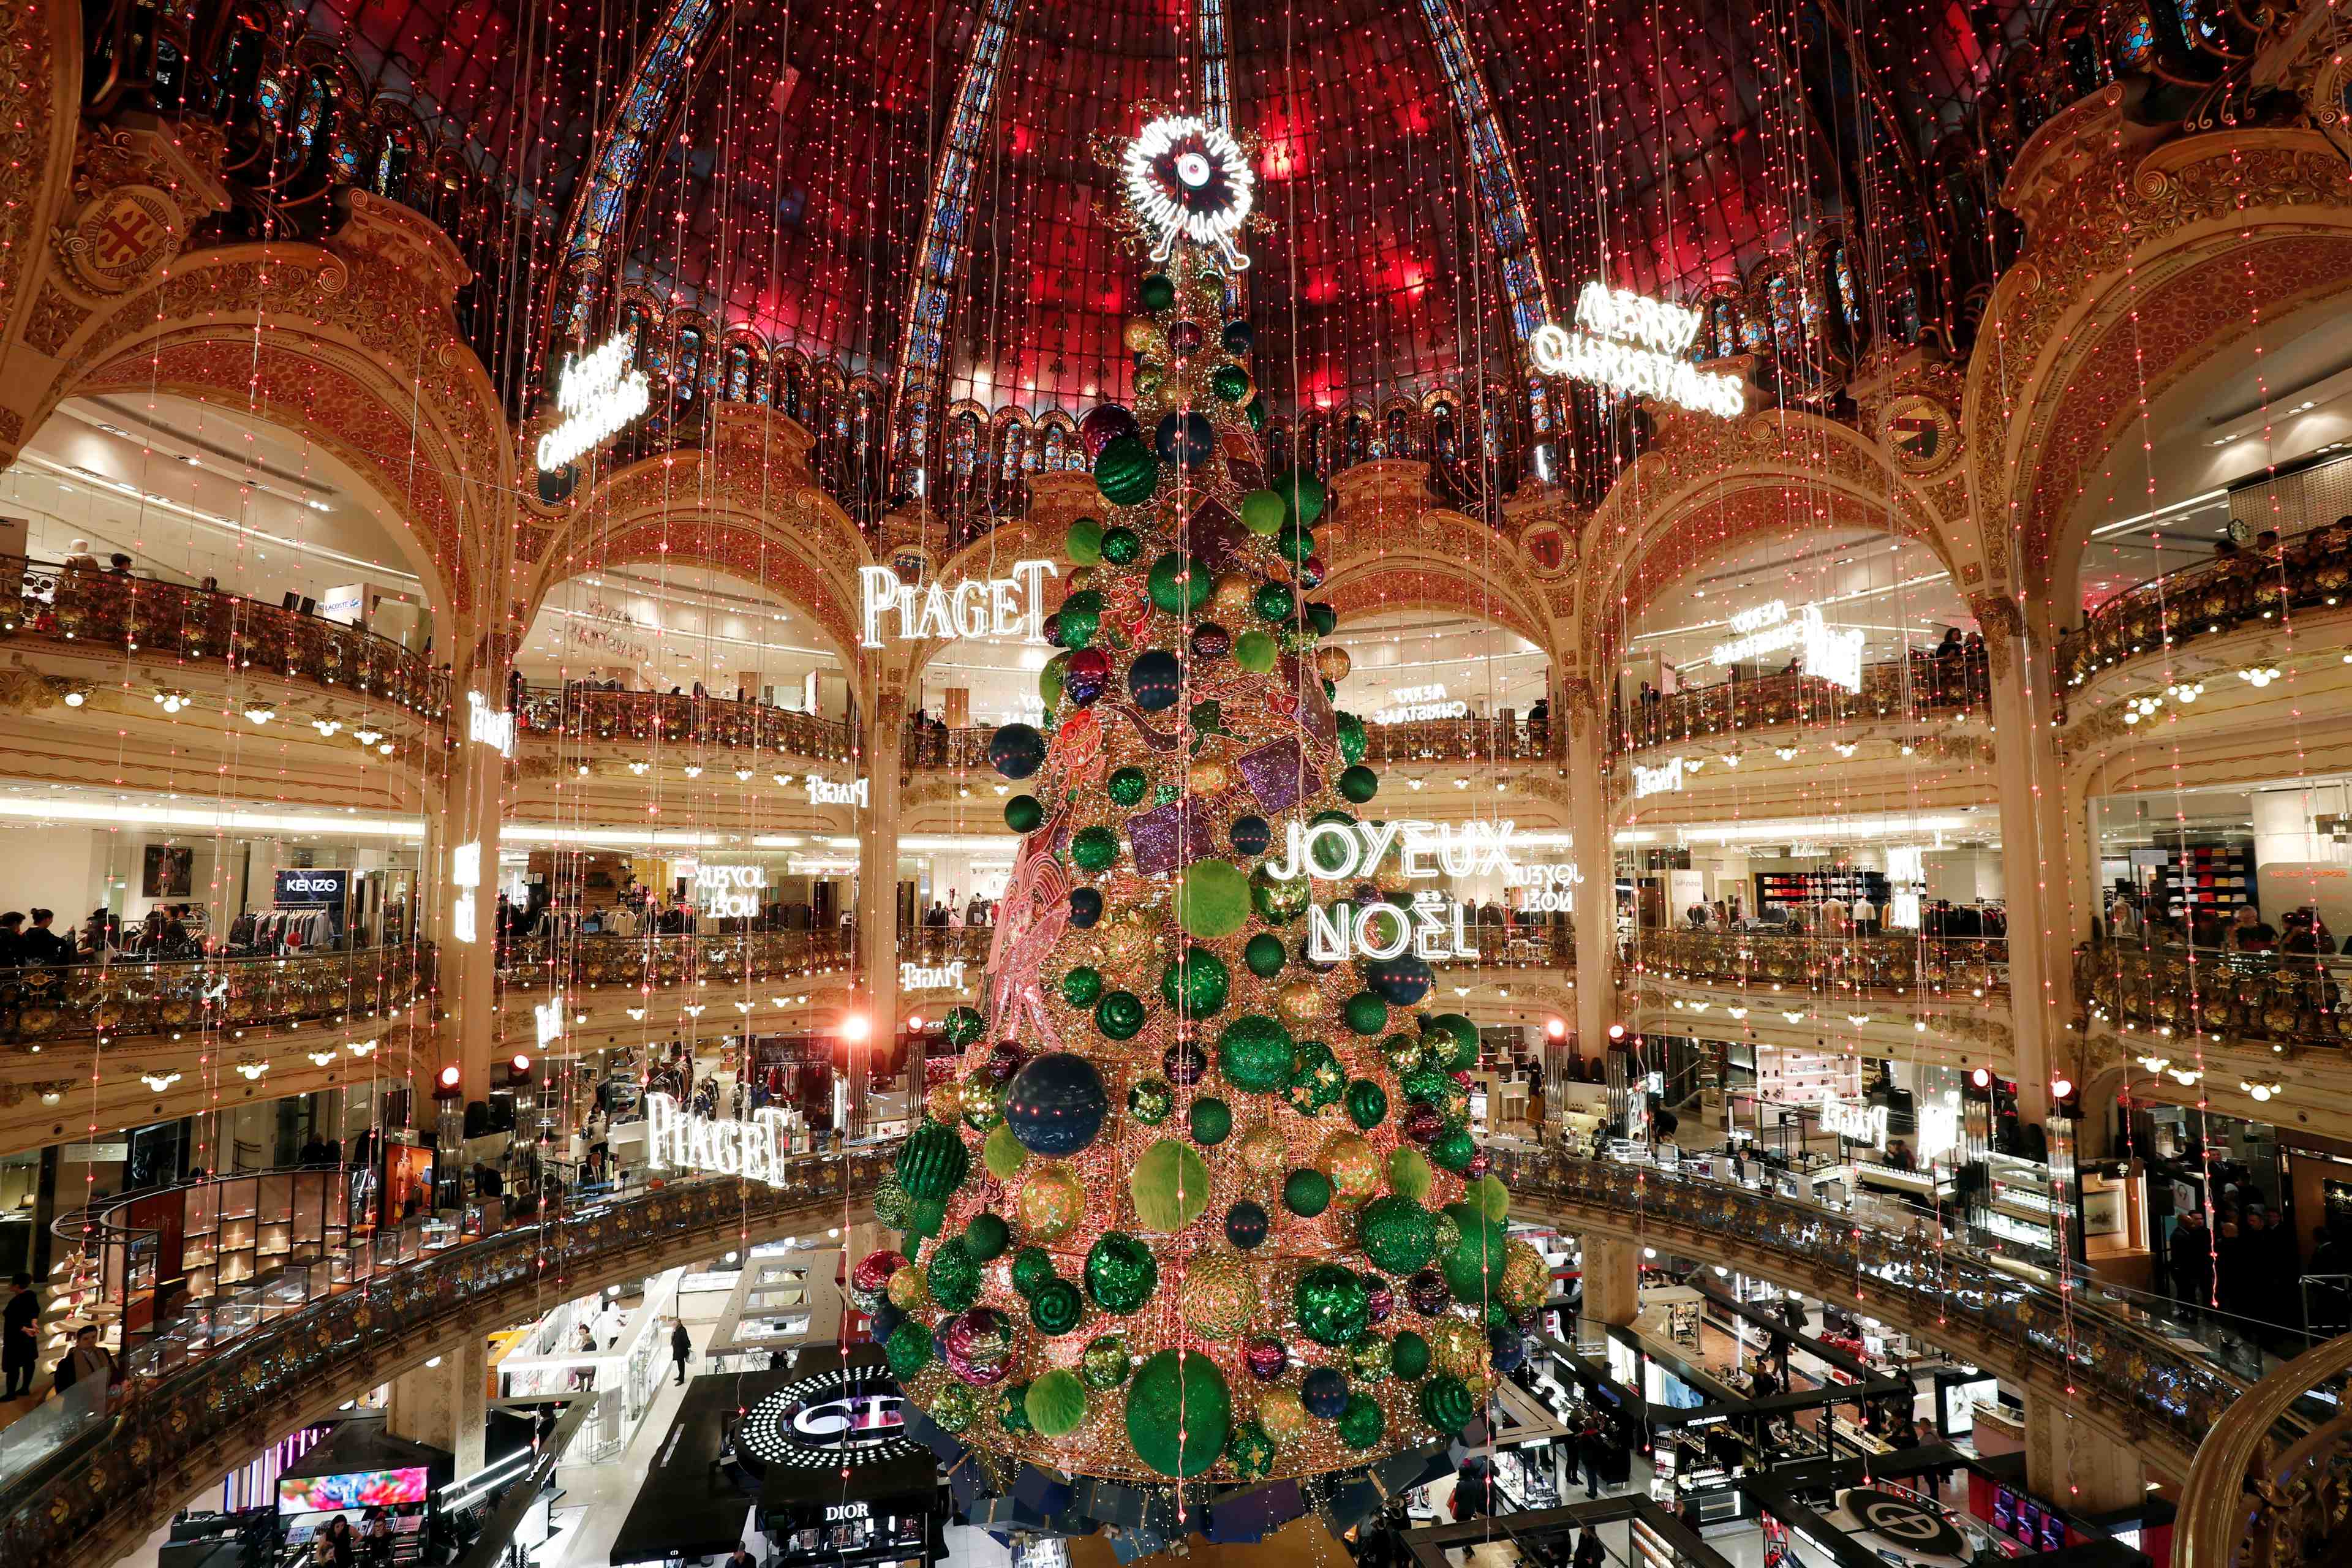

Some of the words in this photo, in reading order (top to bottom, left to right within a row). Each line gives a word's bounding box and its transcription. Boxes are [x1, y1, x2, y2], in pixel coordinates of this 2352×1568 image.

[858, 560, 1059, 649] PIAGET
[1265, 820, 1516, 881] JOYEUX
[286, 879, 337, 892] KENZO
[1308, 891, 1480, 962] NOËL
[645, 1091, 790, 1189] PIAGET
[825, 1504, 869, 1521] DIOR
